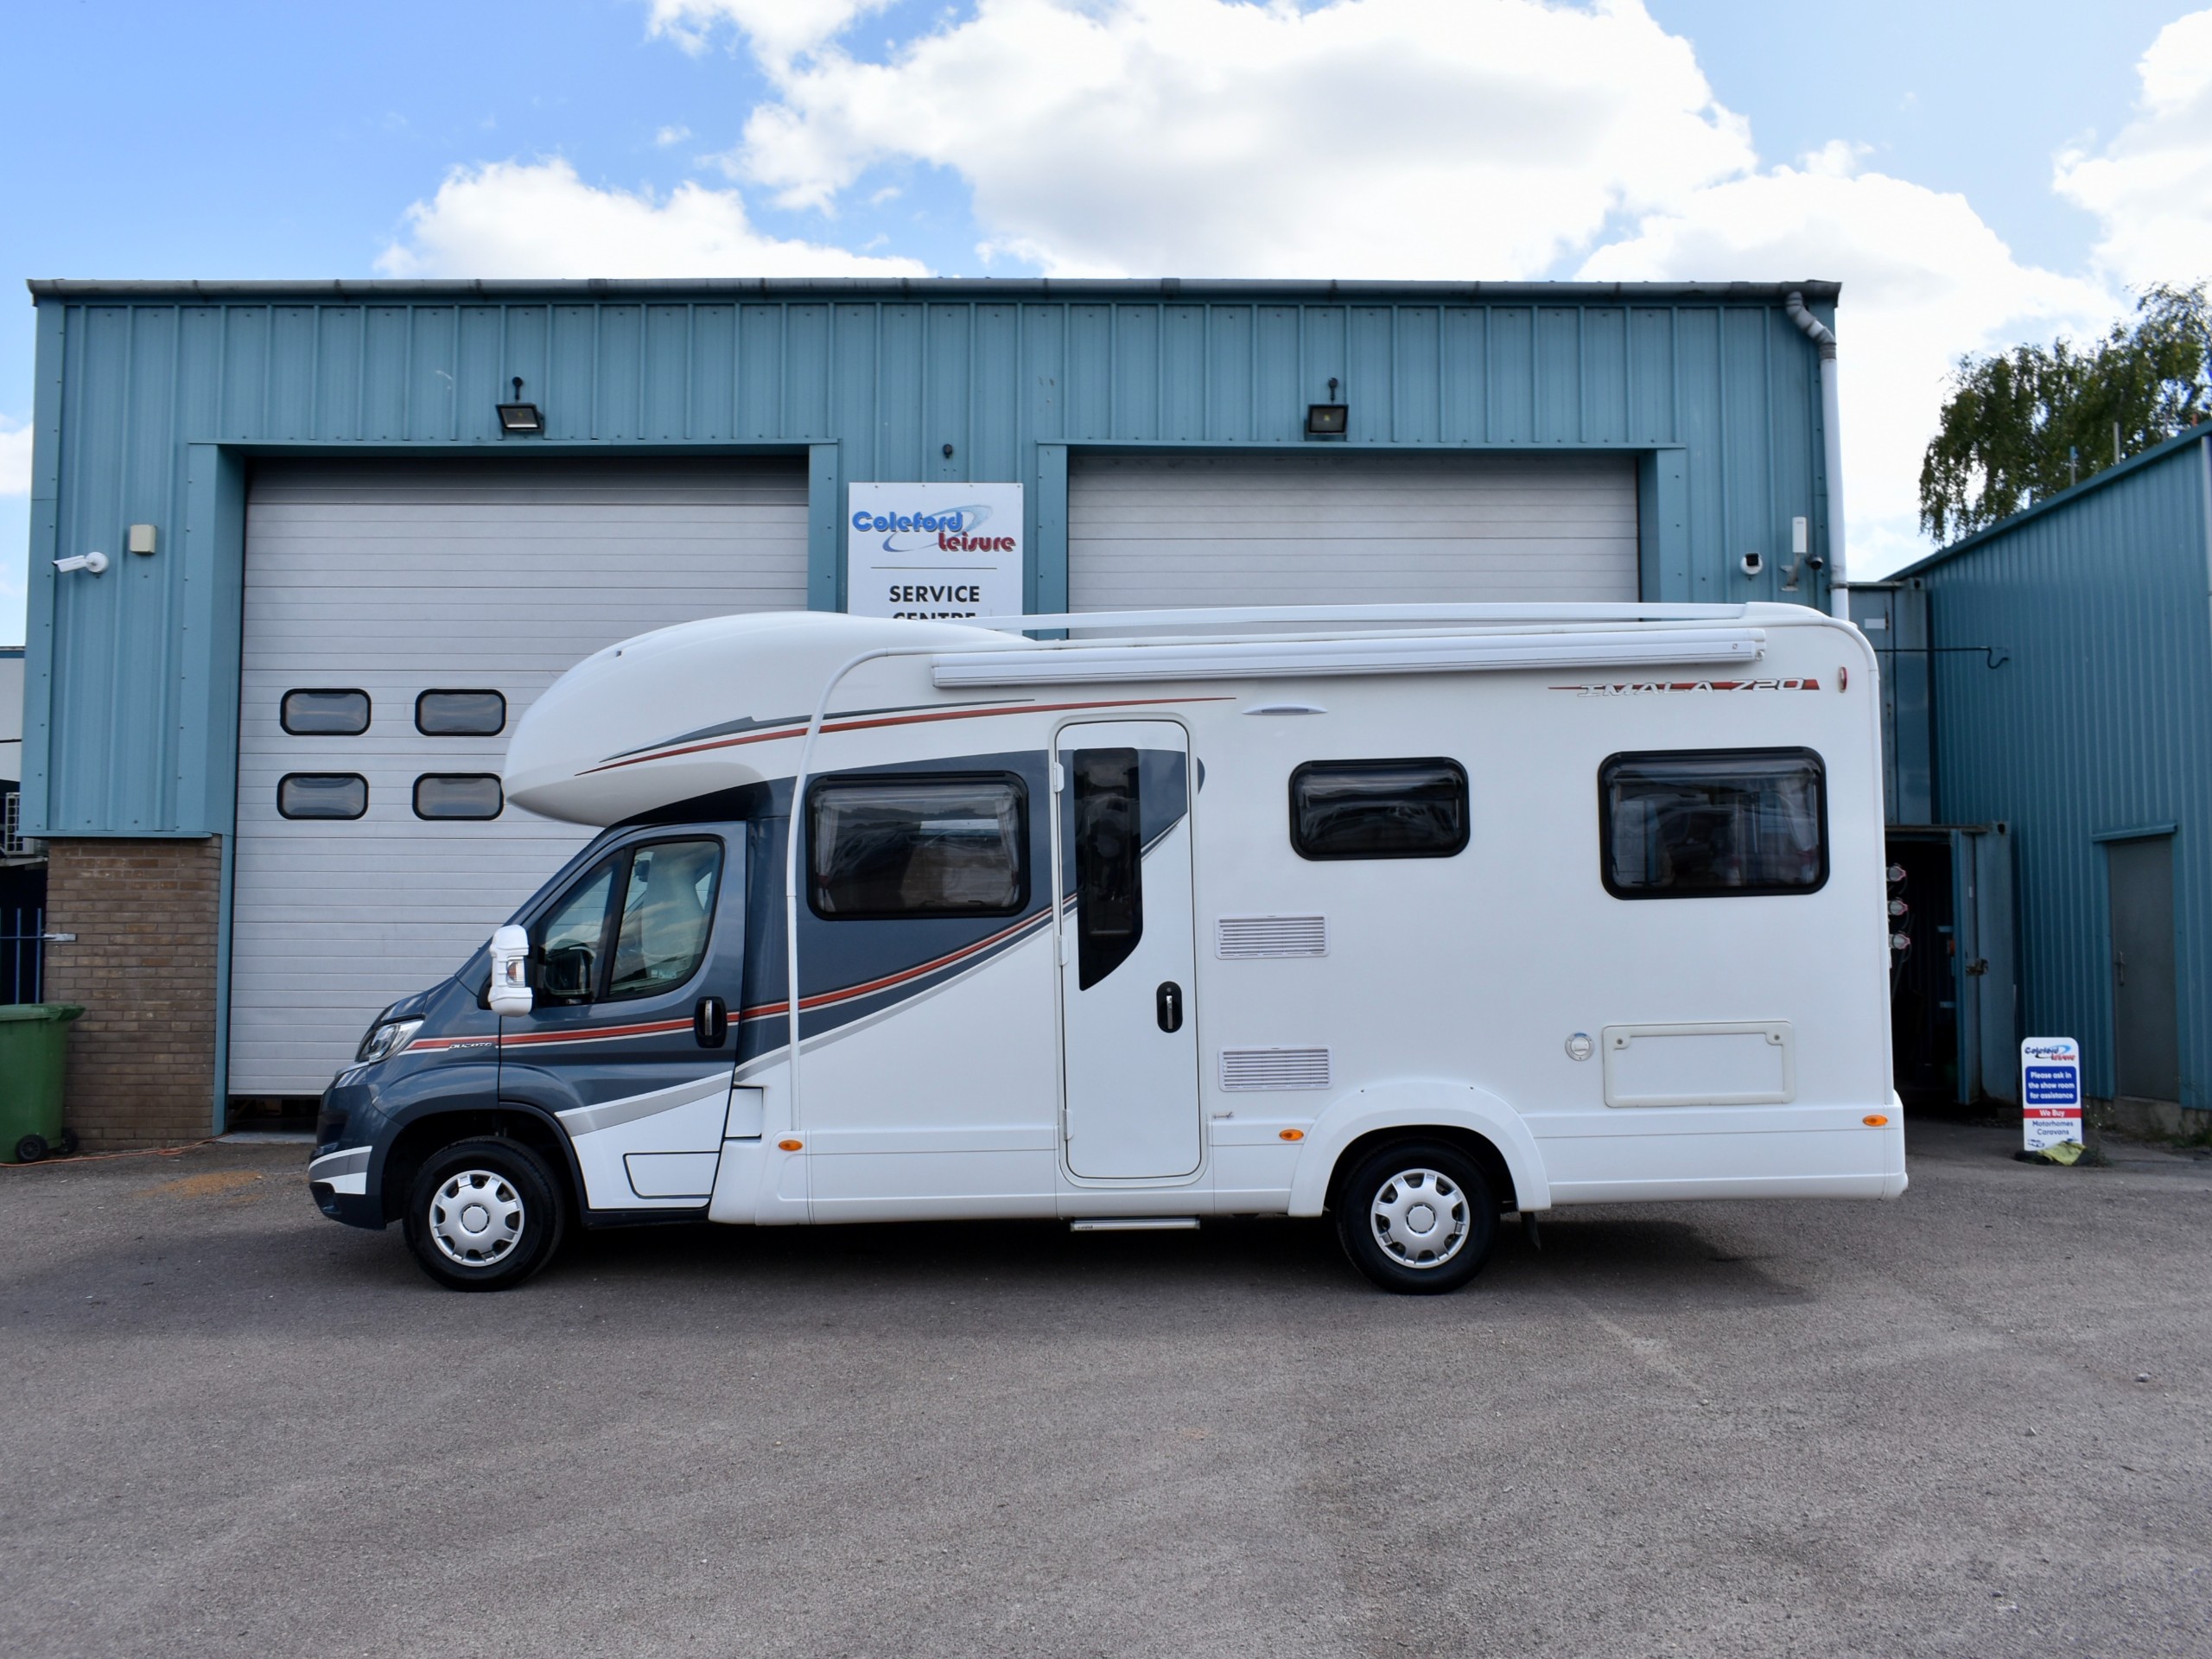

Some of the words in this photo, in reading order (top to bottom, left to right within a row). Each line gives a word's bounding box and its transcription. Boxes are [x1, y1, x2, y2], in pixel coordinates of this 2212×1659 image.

[852, 511, 963, 532] Coleford
[888, 585, 980, 603] SERVICE
[1577, 680, 1714, 697] IMALA
[1729, 677, 1806, 692] 720
[2051, 1109, 2065, 1118] Buy
